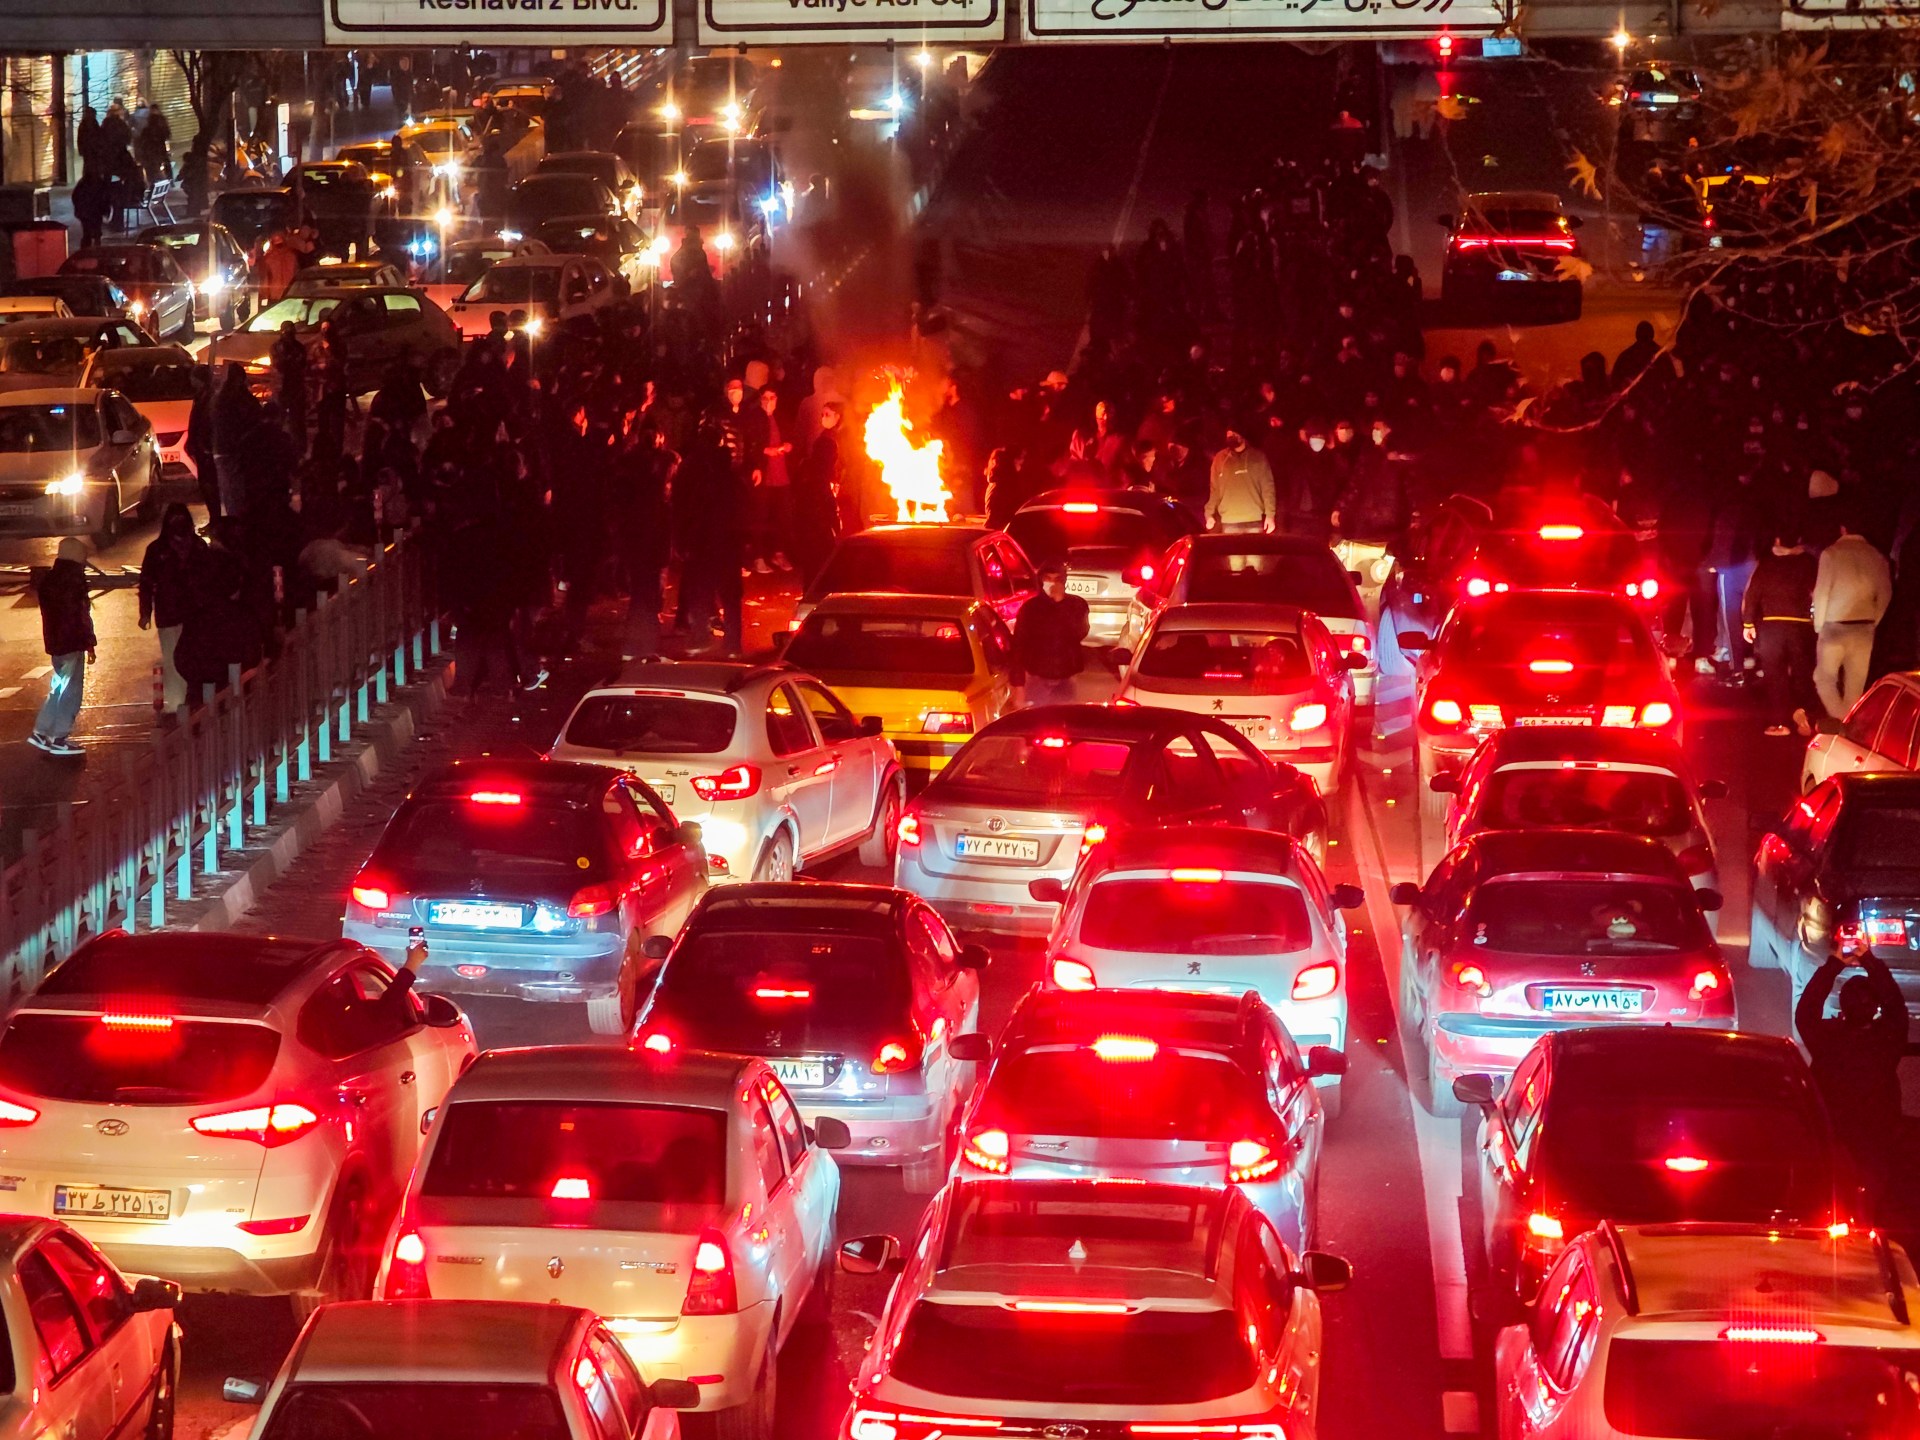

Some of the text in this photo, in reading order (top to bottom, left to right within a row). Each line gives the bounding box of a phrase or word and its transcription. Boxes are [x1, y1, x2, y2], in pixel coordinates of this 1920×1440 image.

[966, 839, 980, 852] ۷۷
[996, 842, 1018, 855] ۷۳۷
[1622, 997, 1638, 1009] ۵۰
[68, 1191, 89, 1209] ۳۳
[92, 1193, 106, 1209] ط
[111, 1193, 142, 1213] ۲۲۵
[148, 1199, 165, 1214] ۱۰
